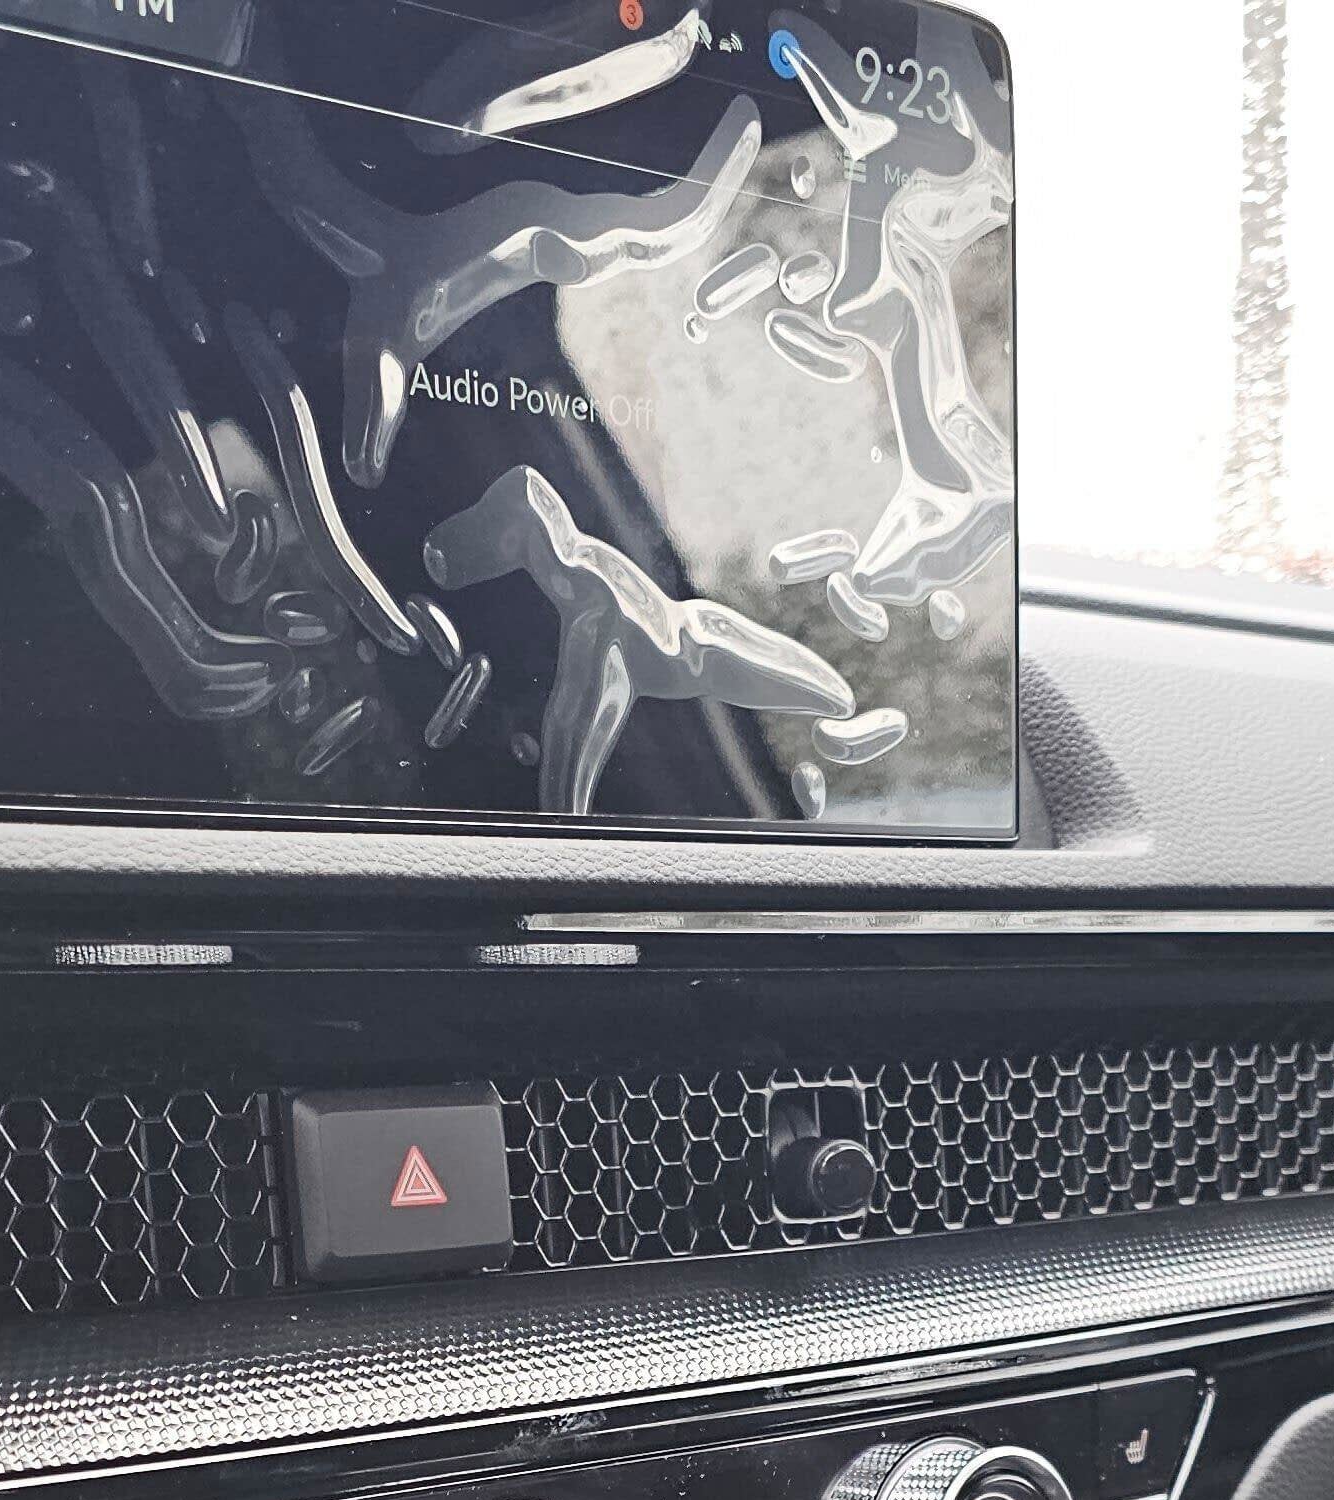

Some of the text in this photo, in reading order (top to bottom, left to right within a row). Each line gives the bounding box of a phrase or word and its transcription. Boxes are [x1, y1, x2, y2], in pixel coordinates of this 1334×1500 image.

[626, 4, 638, 25] 3
[855, 46, 952, 125] 9:23
[884, 163, 931, 193] Me
[410, 362, 655, 431] Audio Power Off
